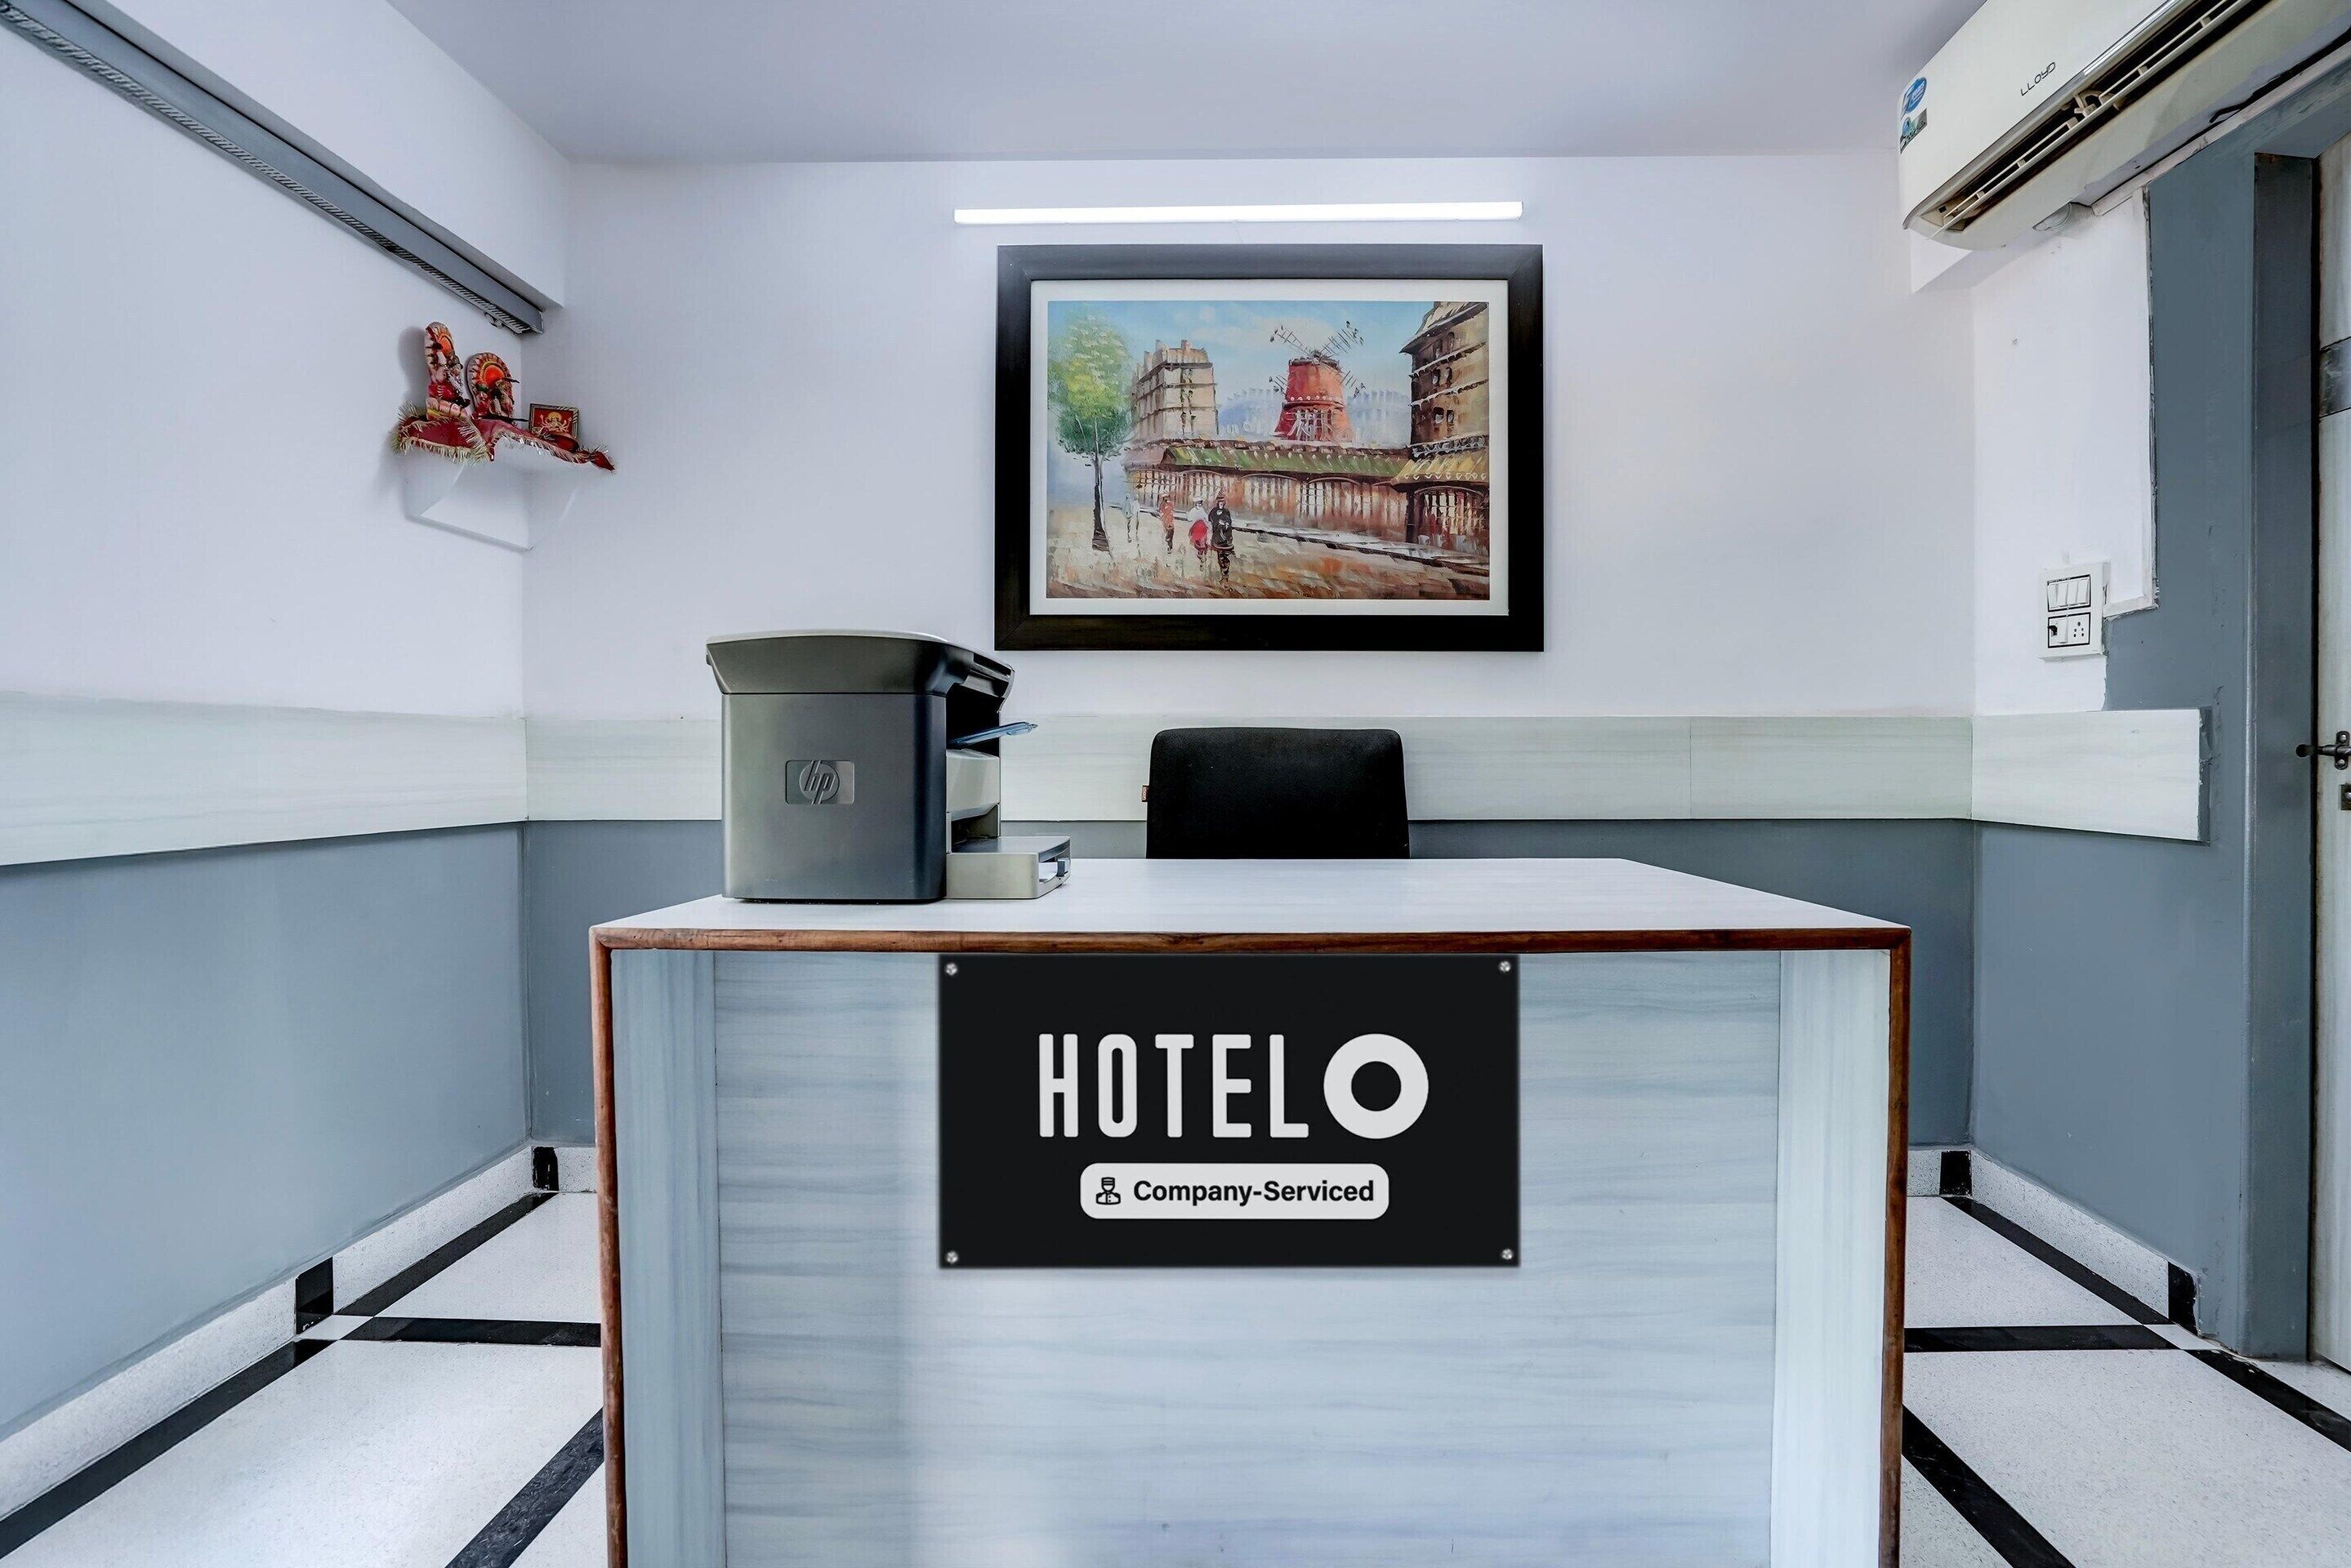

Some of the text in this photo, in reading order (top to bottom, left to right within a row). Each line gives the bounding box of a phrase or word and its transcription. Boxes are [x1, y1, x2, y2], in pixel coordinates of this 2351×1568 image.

[2020, 62, 2056, 96] LLOYD
[804, 760, 836, 805] hp
[1133, 1179, 1375, 1207] Company-Serviced
